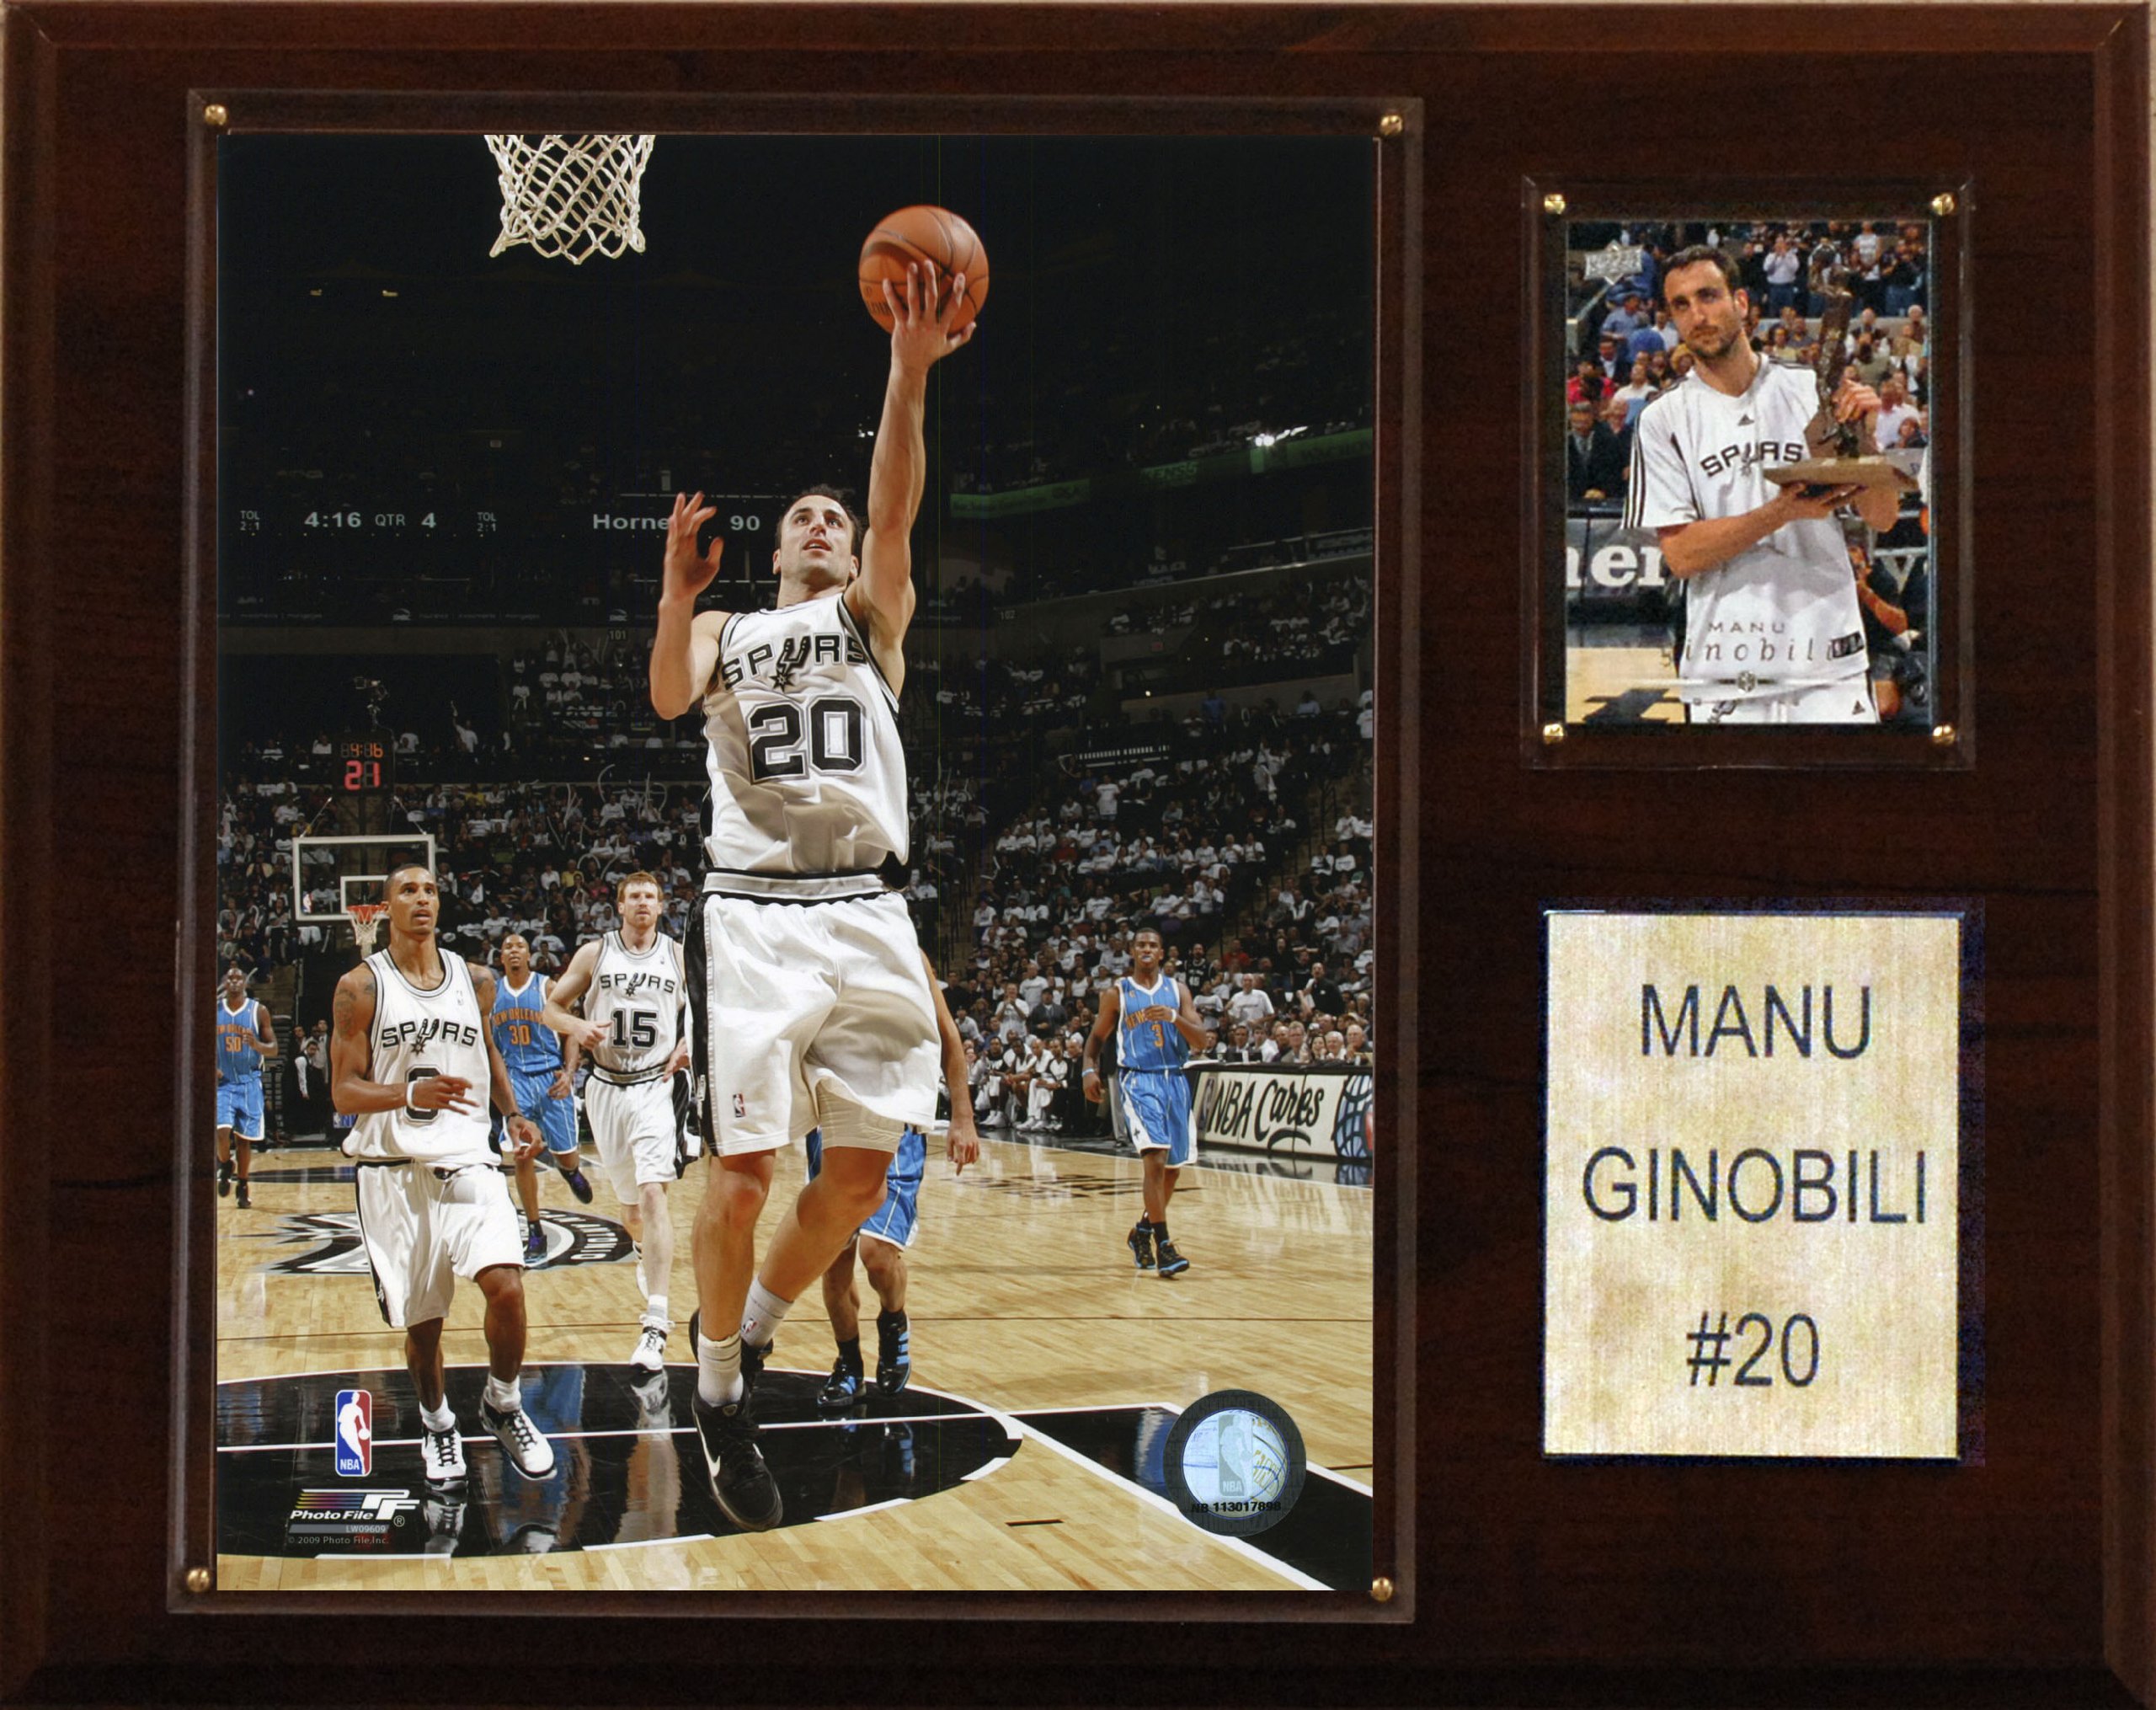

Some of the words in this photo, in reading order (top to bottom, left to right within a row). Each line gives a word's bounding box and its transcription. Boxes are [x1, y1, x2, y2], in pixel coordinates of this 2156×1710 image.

[1700, 441, 1803, 478] SPURS
[240, 510, 261, 521] TOL
[304, 511, 362, 528] 4:16
[375, 514, 406, 527] QTR
[421, 512, 436, 528] 4
[477, 512, 498, 521] TOL
[593, 514, 671, 531] Horne
[730, 516, 760, 531] 90
[609, 630, 627, 640] 101
[1708, 622, 1786, 633] MANU
[721, 634, 867, 692] SPURS
[746, 696, 867, 785] 20
[344, 760, 381, 791] 21
[600, 972, 676, 997] SPURS
[611, 1008, 659, 1050] 15
[1641, 983, 1871, 1060] MANU
[381, 1018, 478, 1057] SPURS
[508, 1024, 531, 1045] 30
[1151, 1023, 1164, 1048] 3
[1206, 1077, 1257, 1139] NBA
[1255, 1078, 1325, 1142] Cares
[1582, 1146, 1926, 1223] GINOBILI
[1685, 1310, 1820, 1389] #20
[1222, 1481, 1242, 1492] NBA
[1192, 1503, 1209, 1513] NB
[1213, 1501, 1281, 1512] 113017898
